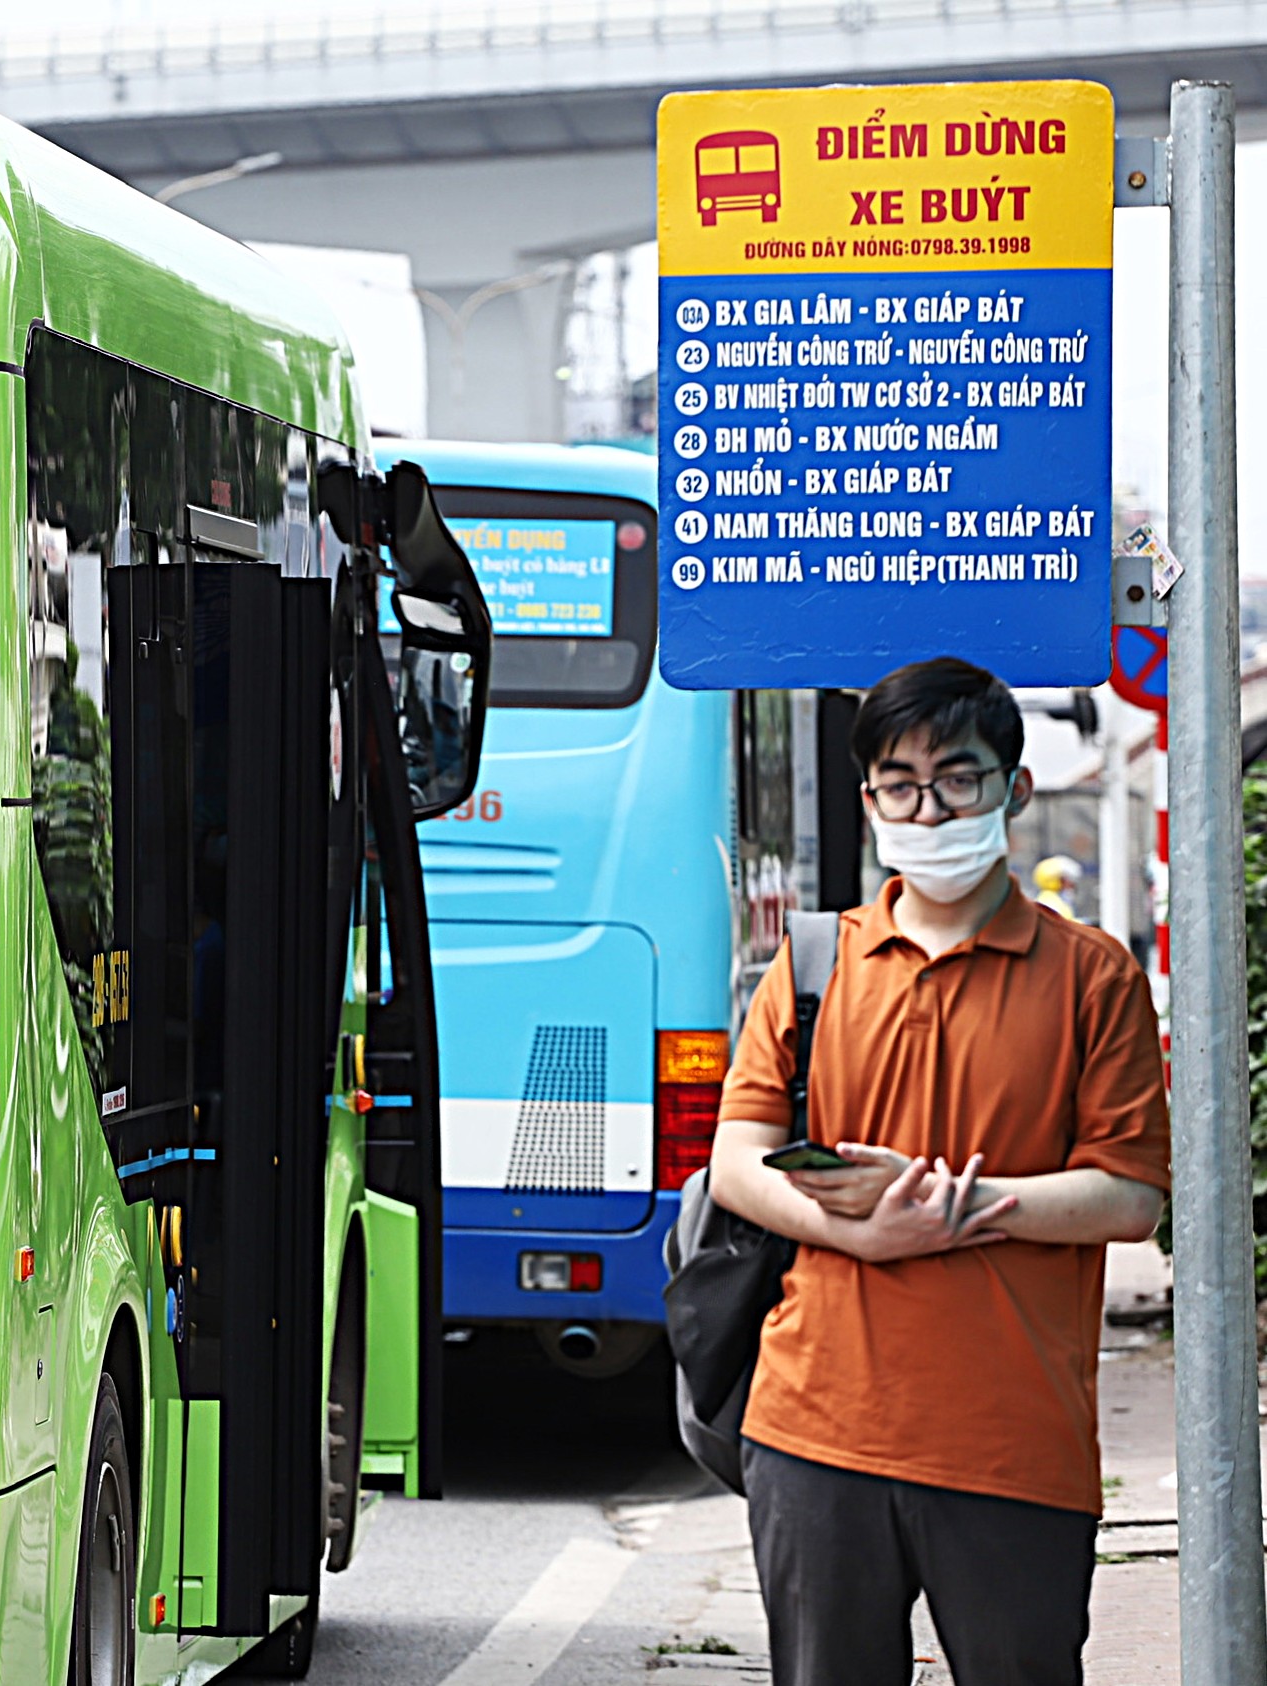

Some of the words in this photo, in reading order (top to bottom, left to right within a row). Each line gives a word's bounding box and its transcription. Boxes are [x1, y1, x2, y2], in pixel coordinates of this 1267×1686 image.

[816, 108, 928, 160] ĐIỂM
[945, 111, 1066, 157] DỪNG
[850, 190, 903, 226] XE
[921, 175, 1031, 224] BUÝT
[744, 236, 806, 260] ĐƯỜNG
[812, 237, 846, 258] DÂY
[682, 306, 704, 324] 03A
[715, 300, 747, 326] BX
[754, 299, 794, 325] GIA
[800, 292, 851, 325] LÂM
[859, 306, 869, 314] -
[875, 298, 907, 323] BX
[914, 290, 971, 323] GIÁP
[977, 289, 1024, 322] BÁT
[683, 347, 703, 365] 23
[797, 334, 849, 366] CÔNG
[854, 331, 893, 365] TRỨ
[909, 329, 985, 364] NGUYỄN
[990, 332, 1043, 363] CÔNG
[1048, 329, 1088, 363] TRỨ
[682, 389, 701, 407] 25
[715, 384, 739, 409] BV
[744, 377, 798, 413] NHIỆT
[803, 373, 835, 408] ĐỚI
[840, 382, 870, 408] TW
[875, 380, 902, 407] CƠ
[906, 371, 933, 407] SỞ
[937, 381, 949, 407] 2
[967, 381, 993, 407] BX
[998, 373, 1043, 407] GIÁP
[1048, 373, 1086, 407] BÁT
[681, 432, 700, 450] 28
[715, 427, 747, 453] ĐH
[754, 417, 792, 453] MỎ
[798, 436, 809, 444] -
[815, 426, 848, 452] BX
[854, 417, 919, 451] NƯỚC
[683, 475, 702, 493] 32
[715, 457, 782, 496] NHỔN
[805, 468, 837, 495] BX
[844, 460, 900, 494] GIÁP
[907, 461, 952, 493] BÁT
[682, 517, 700, 536] 41
[714, 512, 768, 539] NAM
[775, 506, 853, 539] THĂNG
[860, 511, 922, 538] LONG
[929, 521, 940, 529] -
[946, 511, 978, 538] BX
[985, 504, 1041, 537] GIÁP
[1048, 504, 1094, 537] BÁT
[679, 563, 699, 581] 99
[712, 556, 758, 583] KIM
[765, 550, 804, 583] MÃ
[810, 566, 820, 574] -
[826, 550, 875, 583] NGŨ
[1031, 547, 1078, 582] TRÌ)
